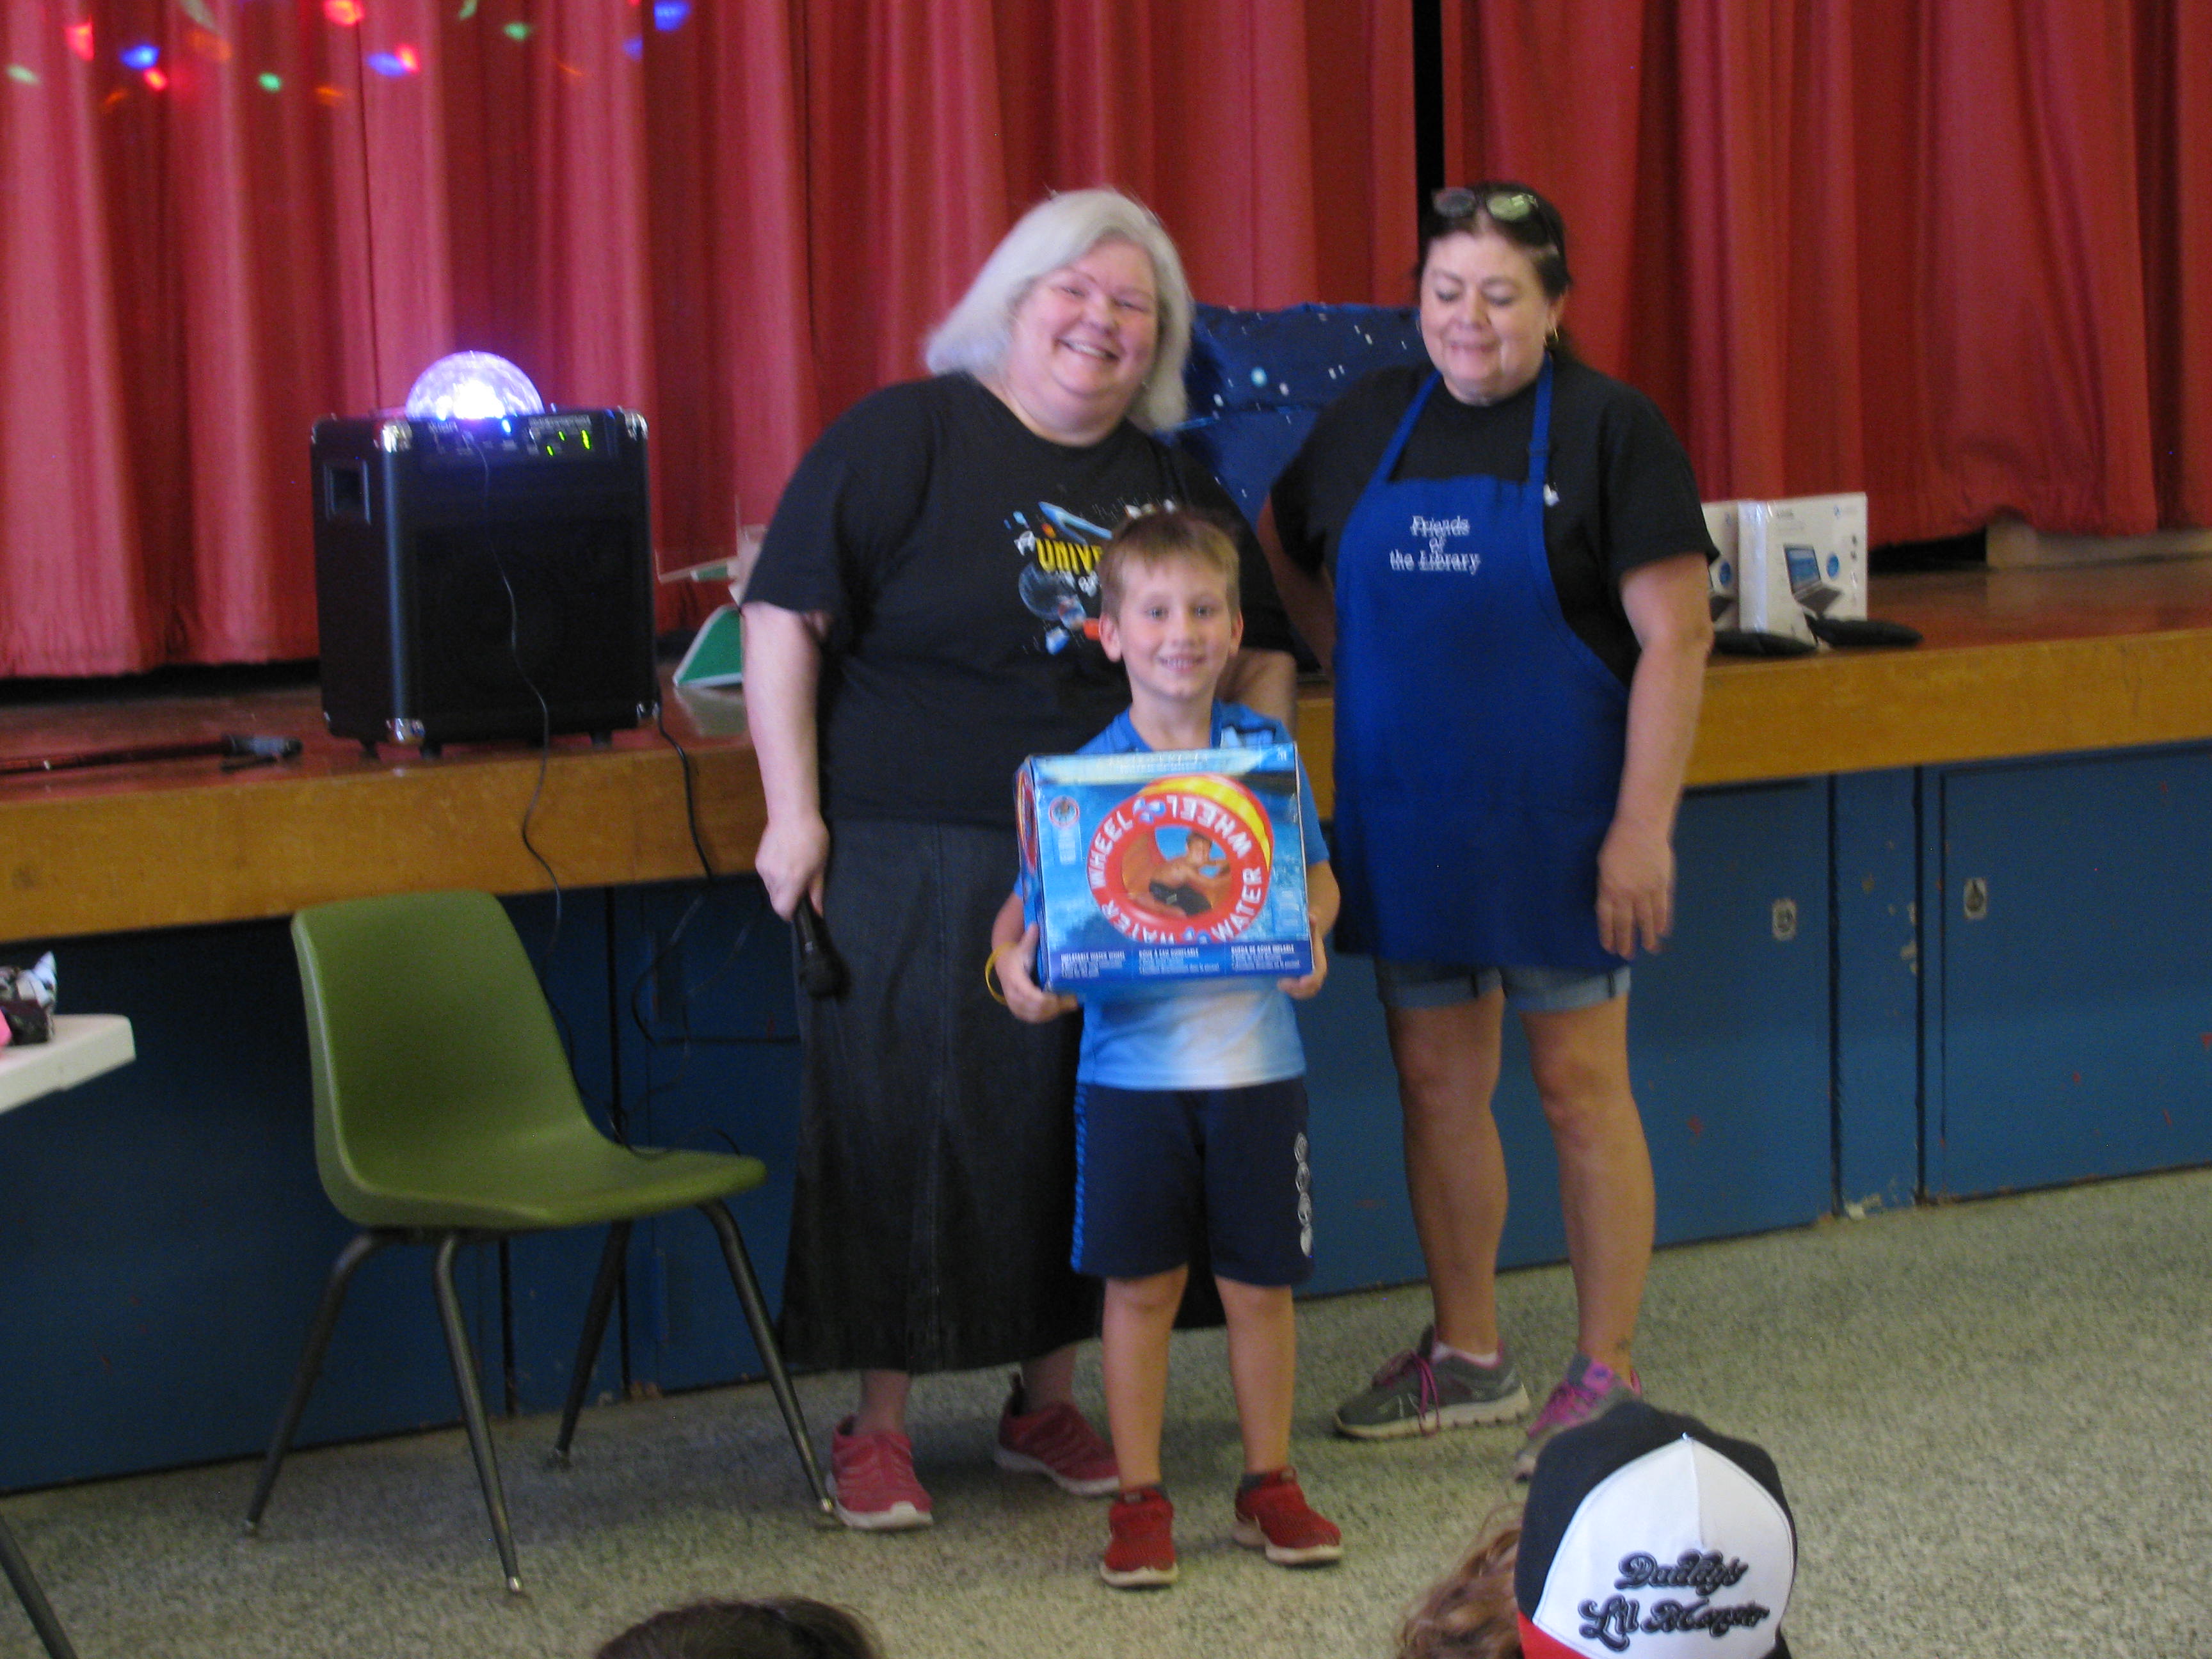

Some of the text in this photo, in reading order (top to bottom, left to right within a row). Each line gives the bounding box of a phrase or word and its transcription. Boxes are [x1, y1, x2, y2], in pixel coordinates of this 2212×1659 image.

[1410, 515, 1470, 538] Friends
[1390, 549, 1481, 575] the Library
[1089, 810, 1134, 890] WHEEL
[1166, 794, 1253, 859] WHEEL
[1210, 867, 1263, 942] WATER
